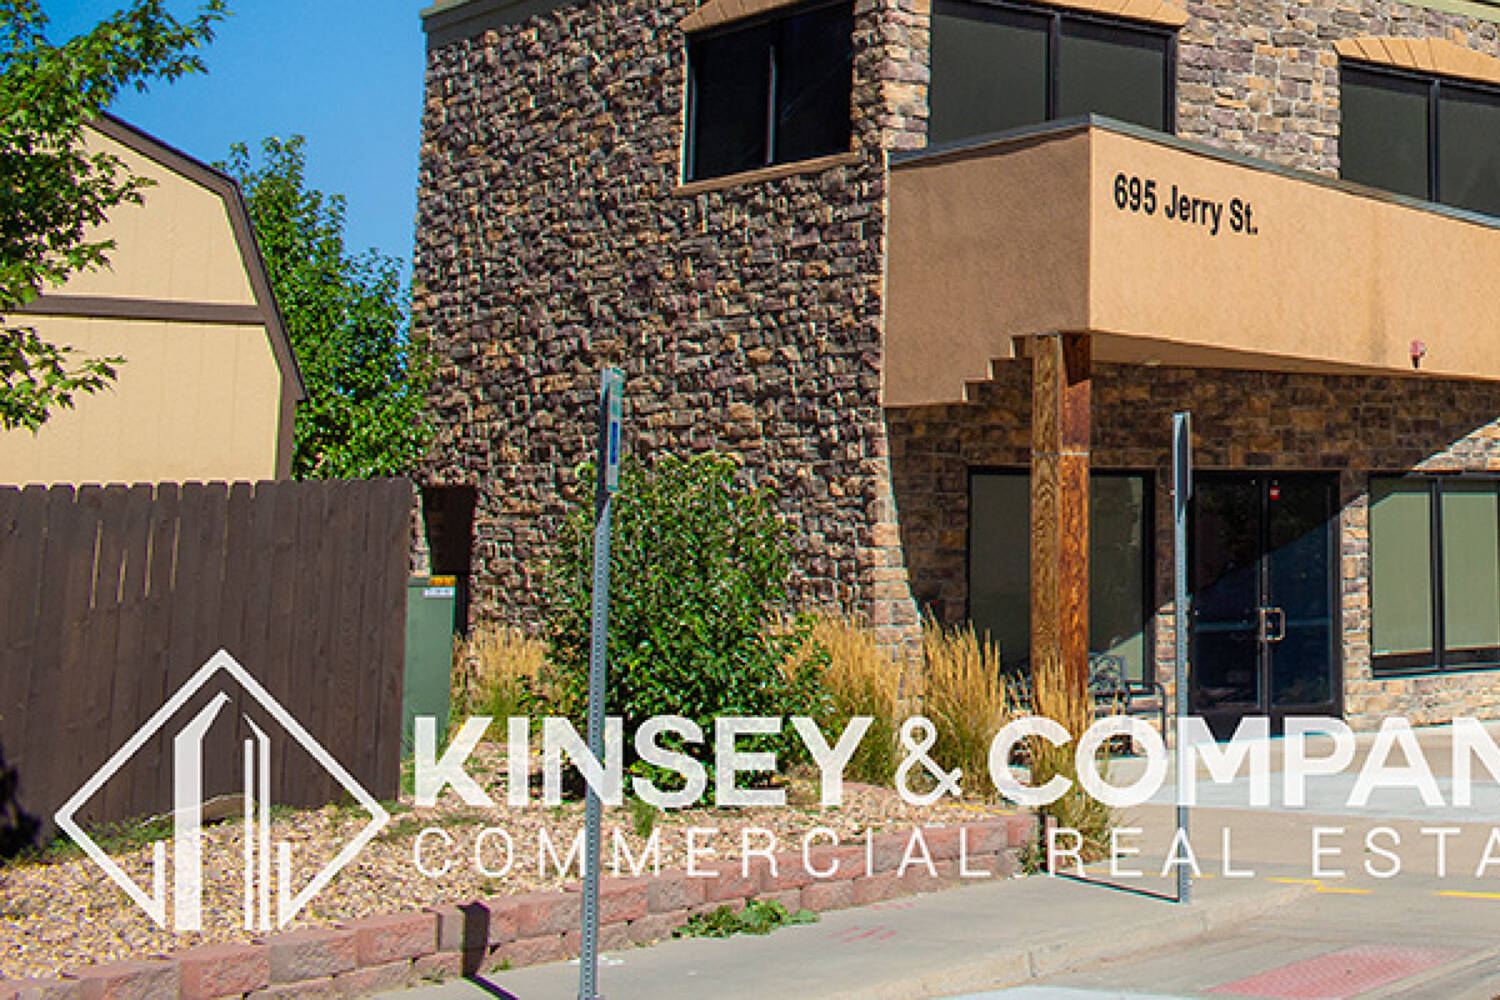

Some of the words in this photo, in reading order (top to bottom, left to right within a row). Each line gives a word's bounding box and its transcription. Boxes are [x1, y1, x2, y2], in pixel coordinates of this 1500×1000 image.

[1114, 172, 1156, 216] 695
[1165, 184, 1223, 235] Jerry
[1230, 197, 1259, 235] St.
